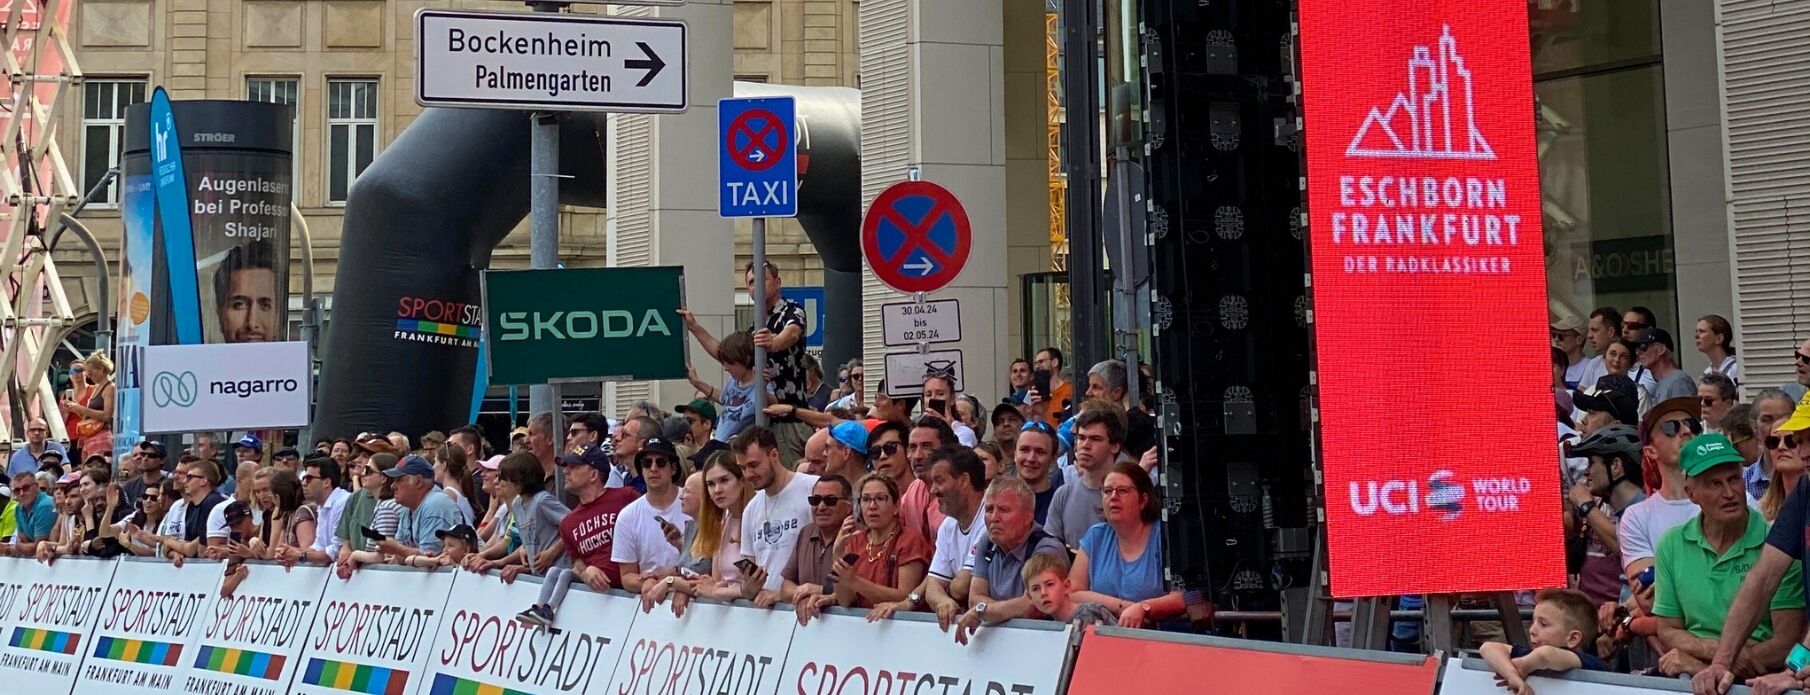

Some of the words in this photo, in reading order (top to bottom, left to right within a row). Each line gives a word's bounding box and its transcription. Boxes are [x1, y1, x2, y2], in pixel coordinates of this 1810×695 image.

[448, 28, 611, 58] Bockenheim
[475, 64, 611, 97] Palmengarten
[155, 122, 168, 163] hr
[726, 180, 788, 206] TAXI
[1339, 175, 1506, 208] ESCHBORN
[194, 199, 223, 214] bei
[229, 199, 288, 217] Professo
[224, 222, 278, 241] Shajari
[1331, 212, 1521, 245] FRANKFURT
[1344, 255, 1378, 273] DER
[1386, 255, 1512, 273] RADKLASSIKER
[398, 296, 481, 325] SPORTSTA
[901, 304, 937, 316] 30.04.24
[913, 318, 928, 328] bis
[394, 331, 458, 346] FRANKFURT
[903, 329, 940, 341] 02.05.24
[209, 376, 298, 398] nagarro
[1349, 479, 1419, 516] UCI
[1472, 477, 1531, 494] WORLD
[1476, 495, 1520, 512] TOUR
[579, 528, 613, 554] HOCKEY
[19, 583, 102, 628] SPORTSTADT
[104, 587, 207, 637] SPORTSTADT
[205, 594, 311, 648] SPORTSTADT
[314, 600, 434, 663] SPORTSTADT
[0, 653, 39, 671] FRANKFURT
[37, 659, 51, 673] AM
[50, 660, 72, 677] MAIN
[441, 609, 612, 695] SPORTSTADT
[85, 664, 134, 685] FRANKFURT
[132, 670, 149, 688] AM
[148, 672, 173, 690] MAIN
[184, 676, 232, 695] FRANKFURT
